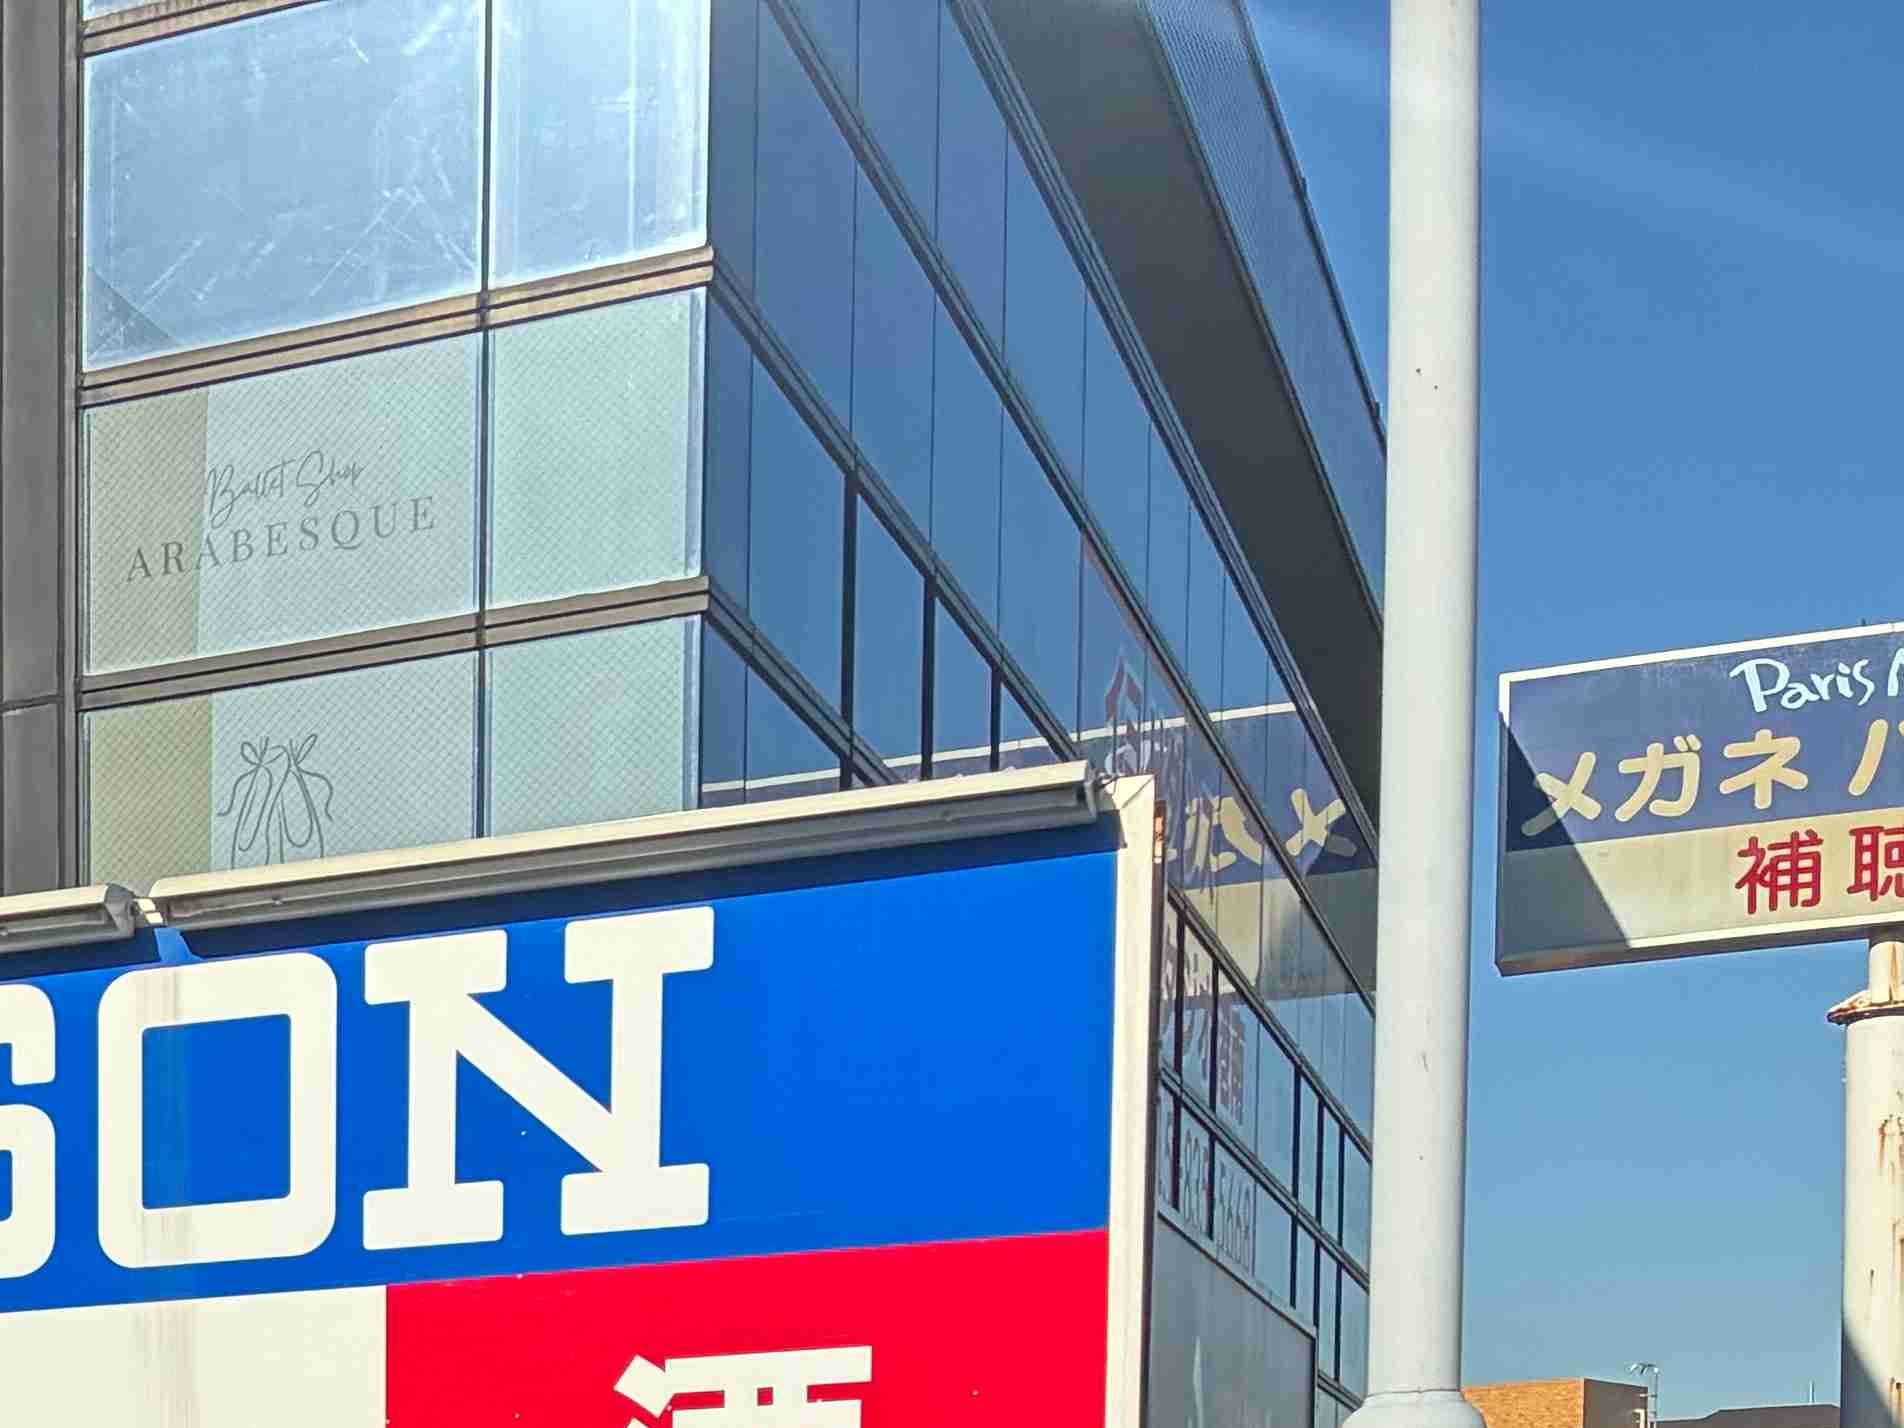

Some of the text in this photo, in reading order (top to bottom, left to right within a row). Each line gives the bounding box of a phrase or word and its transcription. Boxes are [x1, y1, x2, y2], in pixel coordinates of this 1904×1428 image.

[207, 450, 365, 528] Ballet Shop
[127, 496, 435, 582] ARABESQUE
[1729, 657, 1875, 713] Paris
